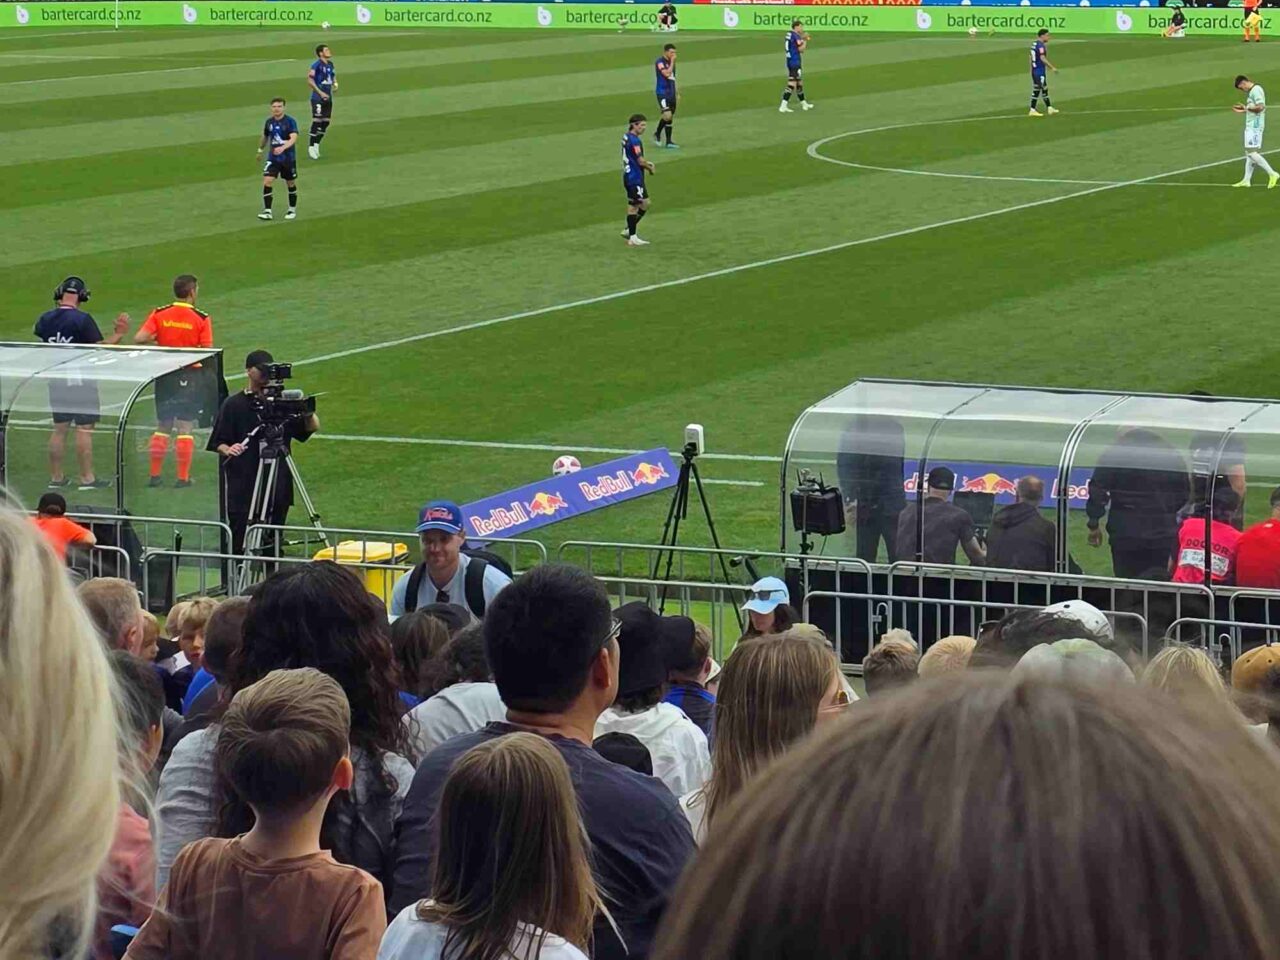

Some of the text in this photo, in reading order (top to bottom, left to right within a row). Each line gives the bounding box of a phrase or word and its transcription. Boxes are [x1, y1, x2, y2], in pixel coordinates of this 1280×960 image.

[41, 7, 141, 21] bartercard.co.nz
[210, 7, 313, 22] bartercard.co.nz
[384, 8, 492, 23] bartercard.co.nz
[946, 13, 1066, 28] bartercard.co.nz
[1186, 538, 1230, 555] DOCOR
